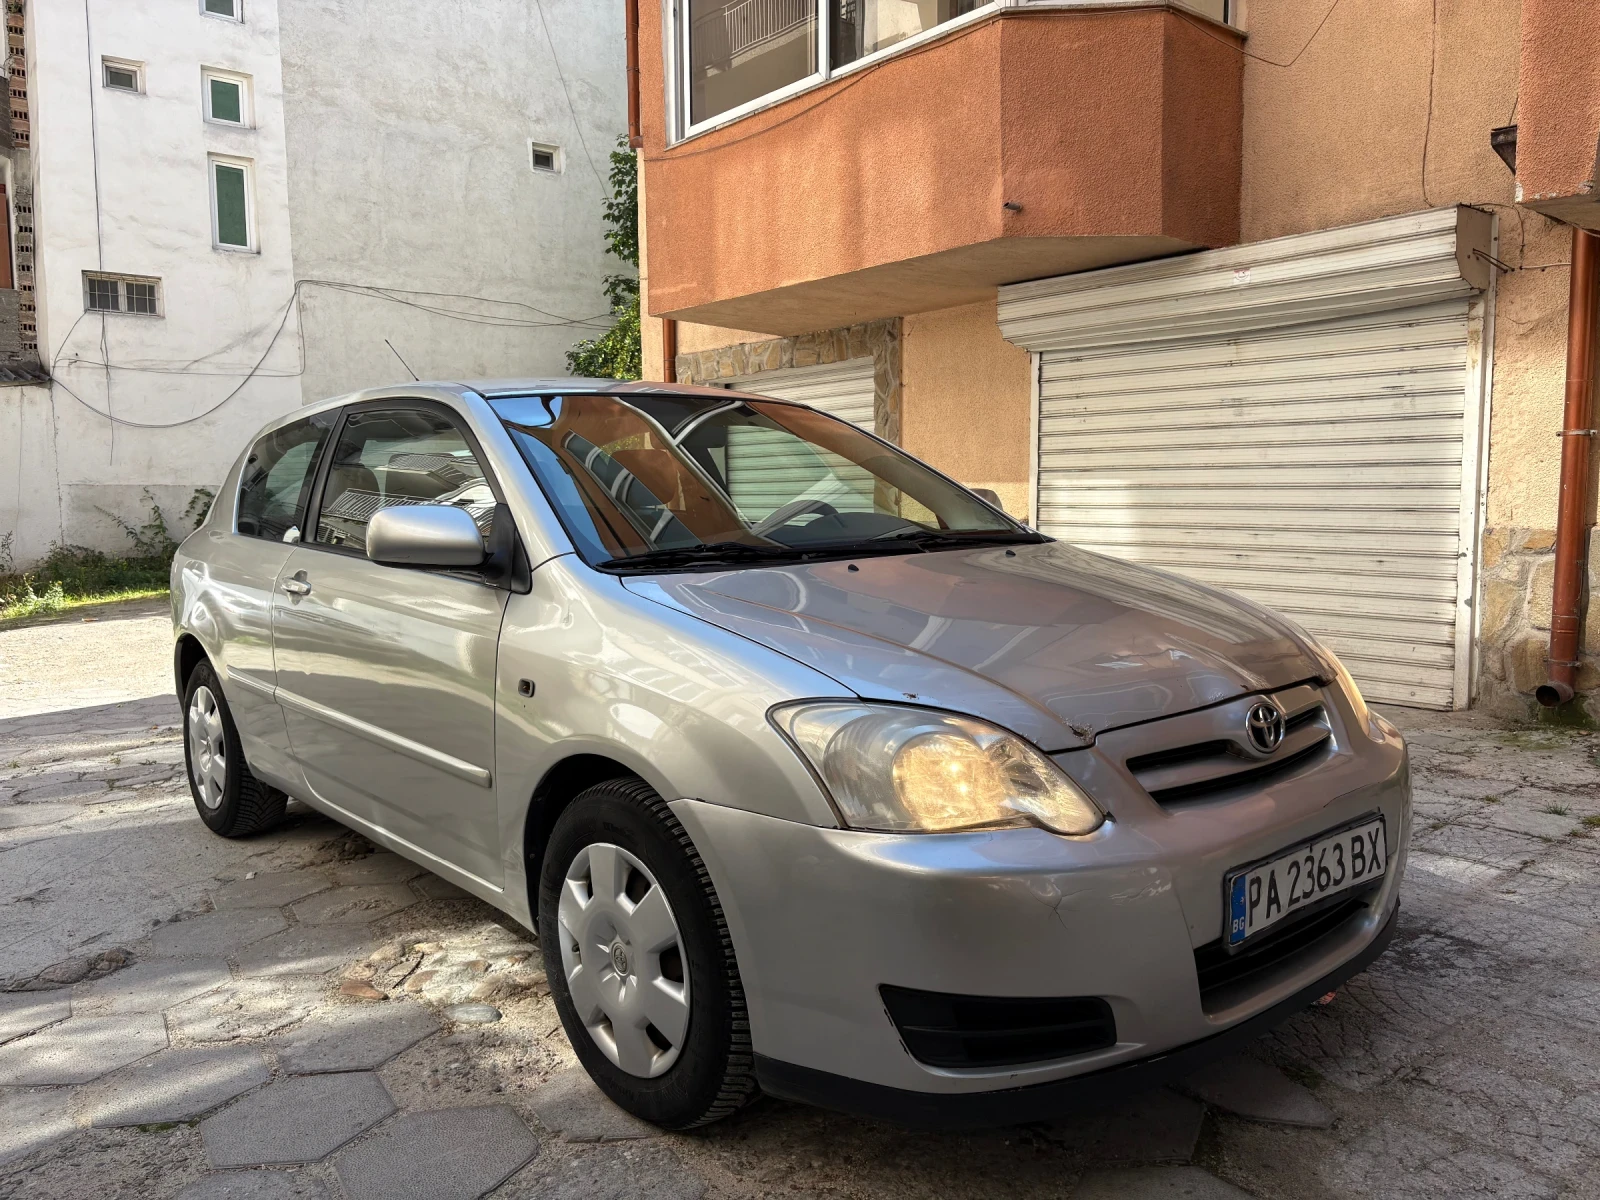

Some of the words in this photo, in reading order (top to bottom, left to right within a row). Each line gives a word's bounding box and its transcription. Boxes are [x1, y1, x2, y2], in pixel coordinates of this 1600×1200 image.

[1249, 869, 1282, 927] PA
[1287, 842, 1346, 908] 2363
[1351, 827, 1381, 879] BX
[1232, 916, 1245, 933] BG
